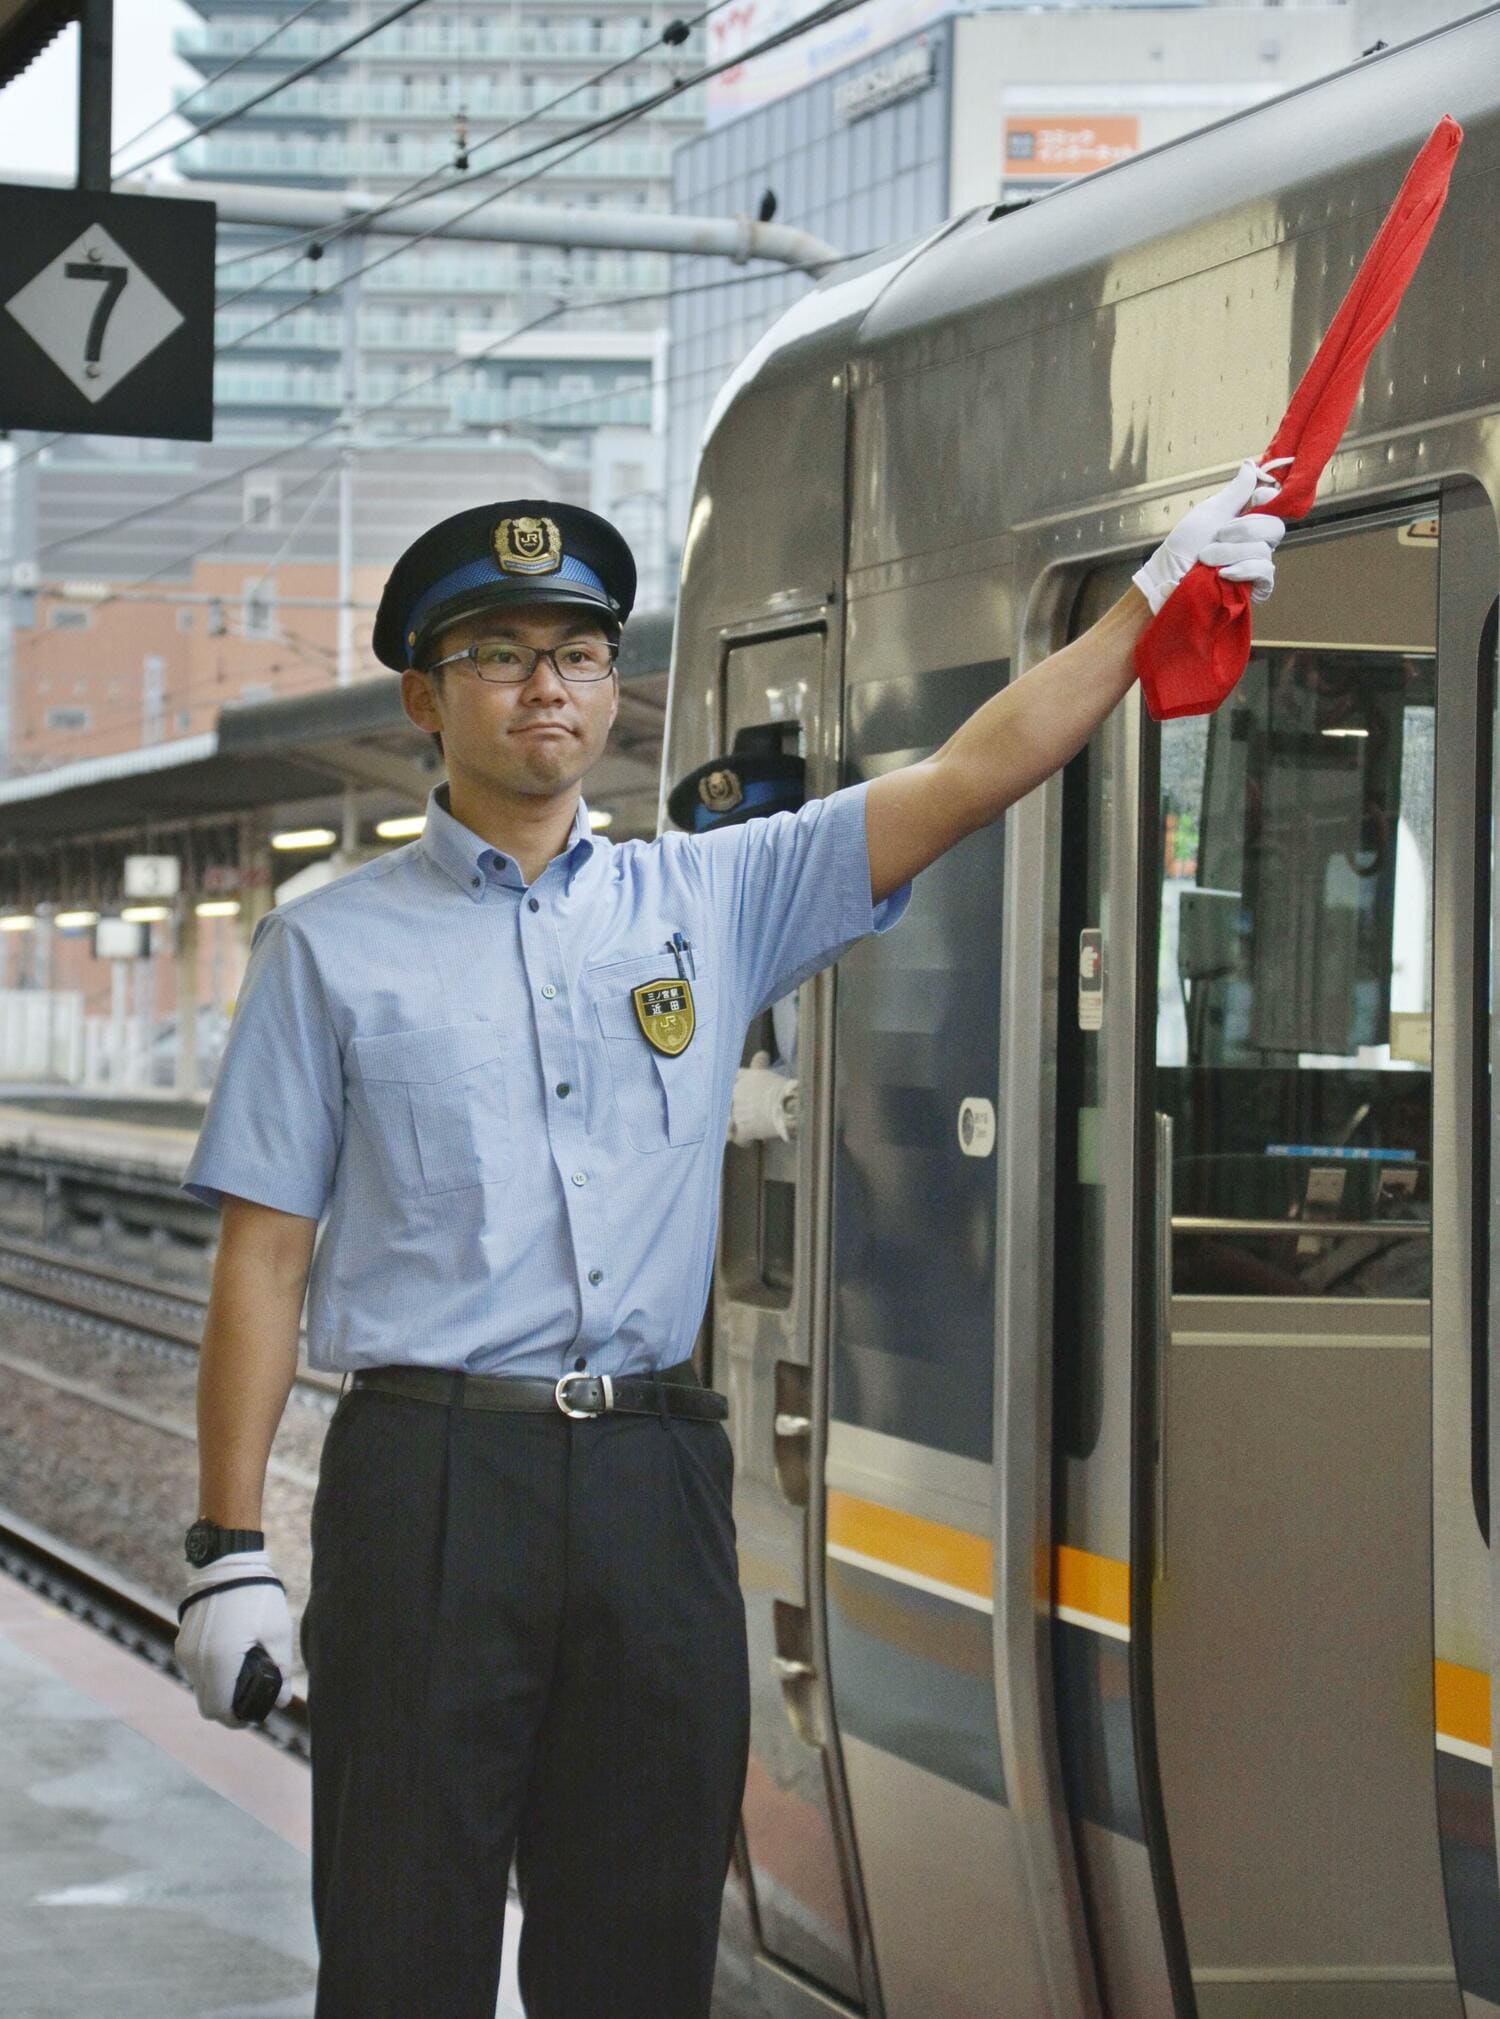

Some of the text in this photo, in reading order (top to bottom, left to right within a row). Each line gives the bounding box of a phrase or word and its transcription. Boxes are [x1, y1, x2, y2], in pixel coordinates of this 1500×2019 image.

[64, 262, 128, 362] 7
[520, 533, 538, 543] JR
[660, 1015, 677, 1028] JR
